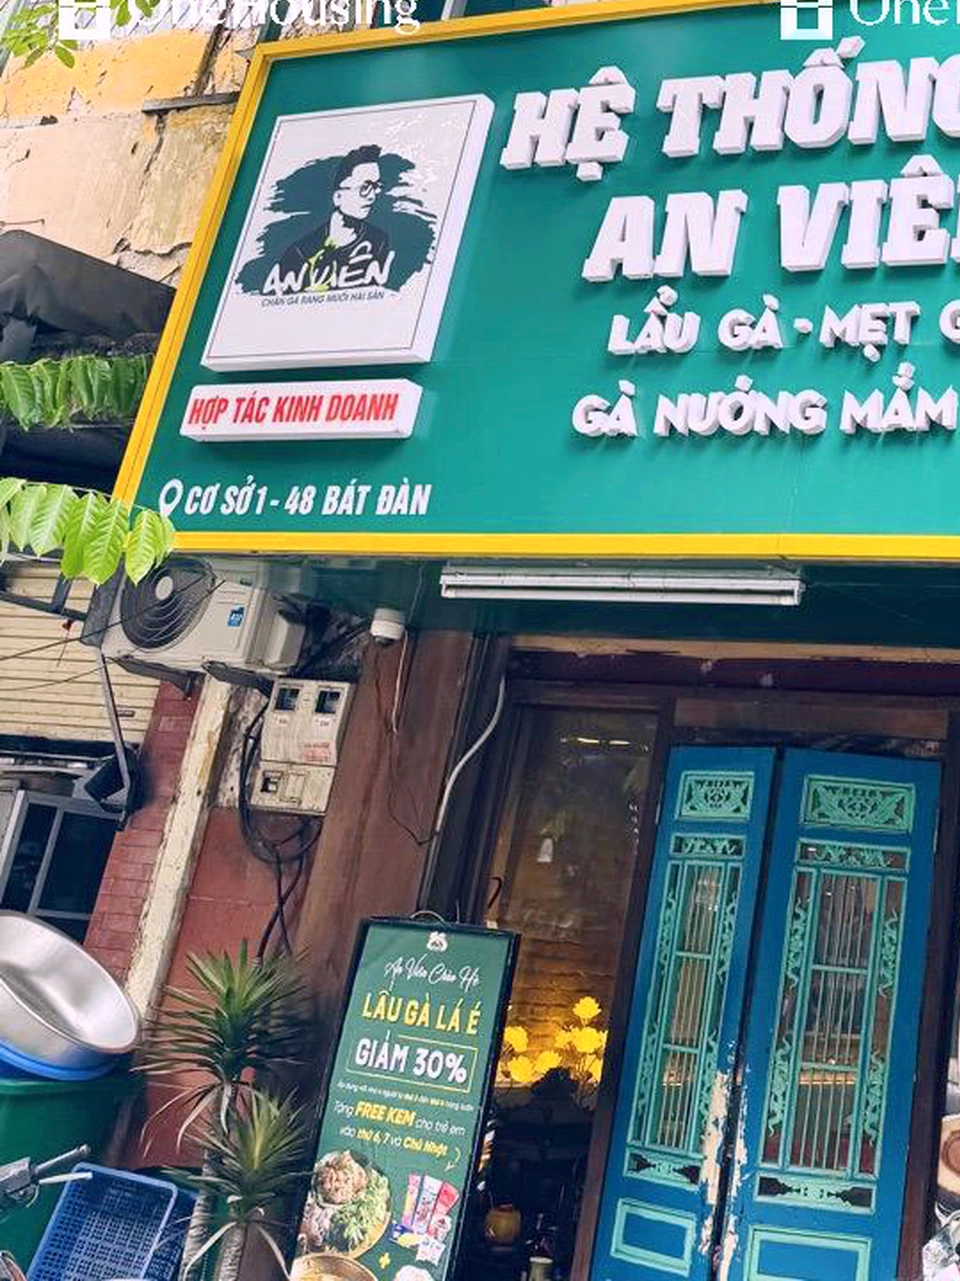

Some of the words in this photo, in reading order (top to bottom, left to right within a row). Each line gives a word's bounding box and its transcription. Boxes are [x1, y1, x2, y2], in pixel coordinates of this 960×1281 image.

[501, 66, 635, 181] HỆ
[581, 190, 749, 283] AN
[262, 263, 308, 296] AN
[608, 285, 701, 355] LẨU
[718, 294, 783, 351] GÀ
[819, 300, 921, 362] MẸT
[188, 395, 228, 431] HỢP
[232, 389, 269, 424] TÁC
[272, 394, 324, 423] KINH
[325, 393, 399, 421] DOANH
[572, 379, 638, 437] GÀ
[184, 482, 220, 515] CƠ
[284, 484, 317, 515] 48
[321, 479, 372, 515] BÁT
[375, 477, 432, 515] ĐÀN
[404, 993, 430, 1027] GÀ
[435, 998, 463, 1033] LÁ
[466, 1001, 481, 1035] É
[355, 1030, 410, 1073] GIẢM
[412, 1047, 467, 1083] 30%
[354, 1101, 387, 1121] FREE
[386, 1106, 416, 1126] KEM
[415, 1118, 433, 1131] cho
[449, 1126, 466, 1136] em
